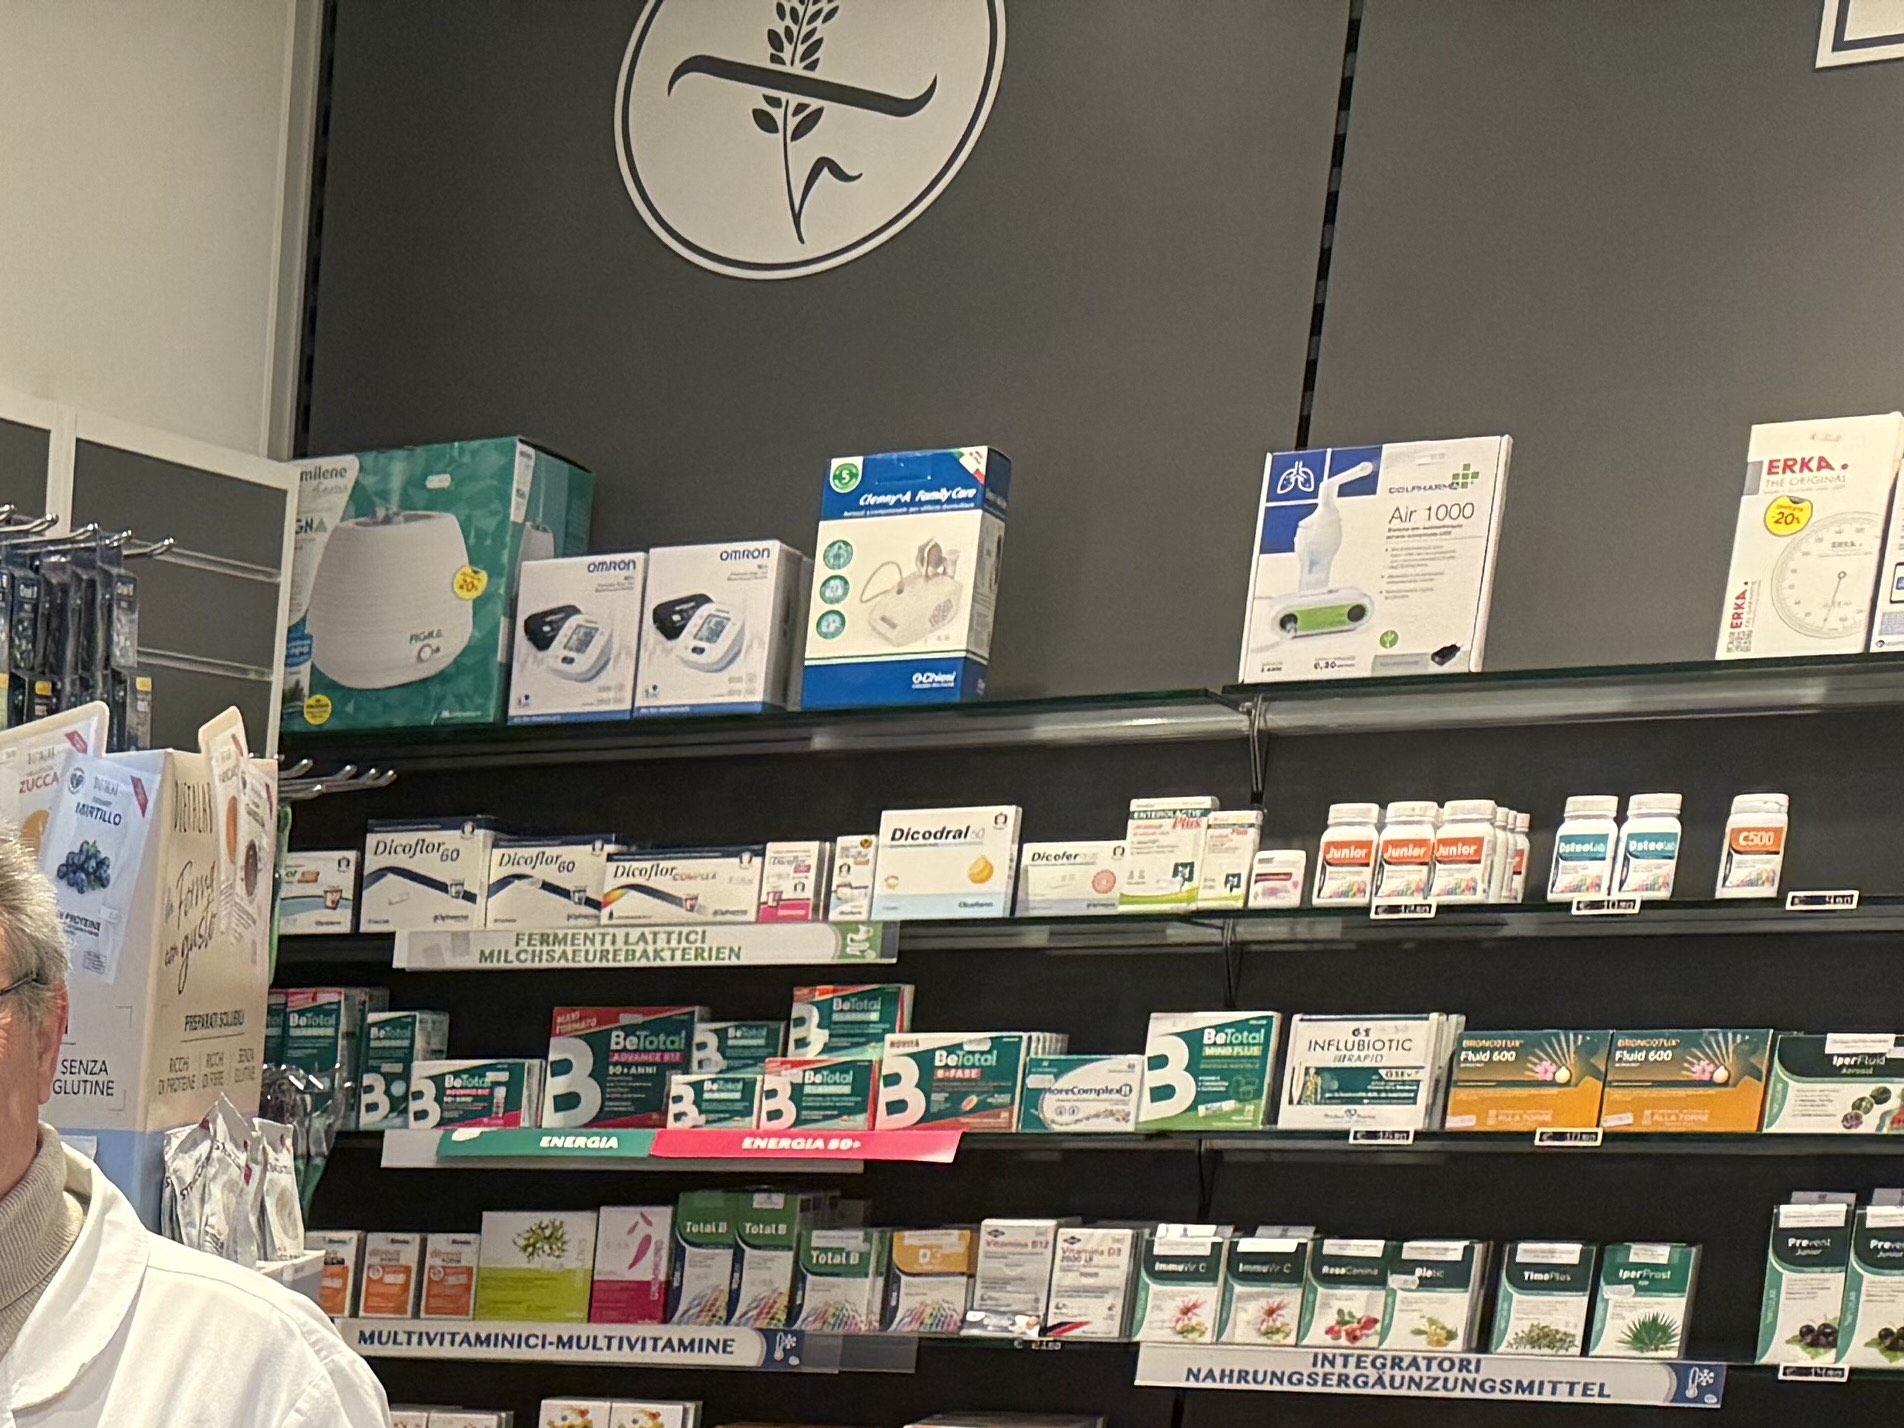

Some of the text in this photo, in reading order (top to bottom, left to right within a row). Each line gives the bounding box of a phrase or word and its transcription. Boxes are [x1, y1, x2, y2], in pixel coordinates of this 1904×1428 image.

[1388, 502, 1475, 525] Air 1000
[719, 548, 770, 563] OMRON
[890, 825, 970, 843] Dicodral
[373, 837, 445, 858] Dicoflor
[1325, 843, 1369, 861] Junior
[514, 929, 707, 948] FERMENTI LATTICI
[478, 945, 742, 964] MILCHSAEUREBAKTERIEN
[609, 1029, 686, 1052] BeTotal
[1307, 1036, 1413, 1053] INFLUBIOTIC
[61, 1058, 109, 1076] SENZA
[52, 1078, 114, 1098] GLUTINE
[538, 1136, 619, 1150] ENERGIA
[1311, 1353, 1482, 1375] INTEGRATORI
